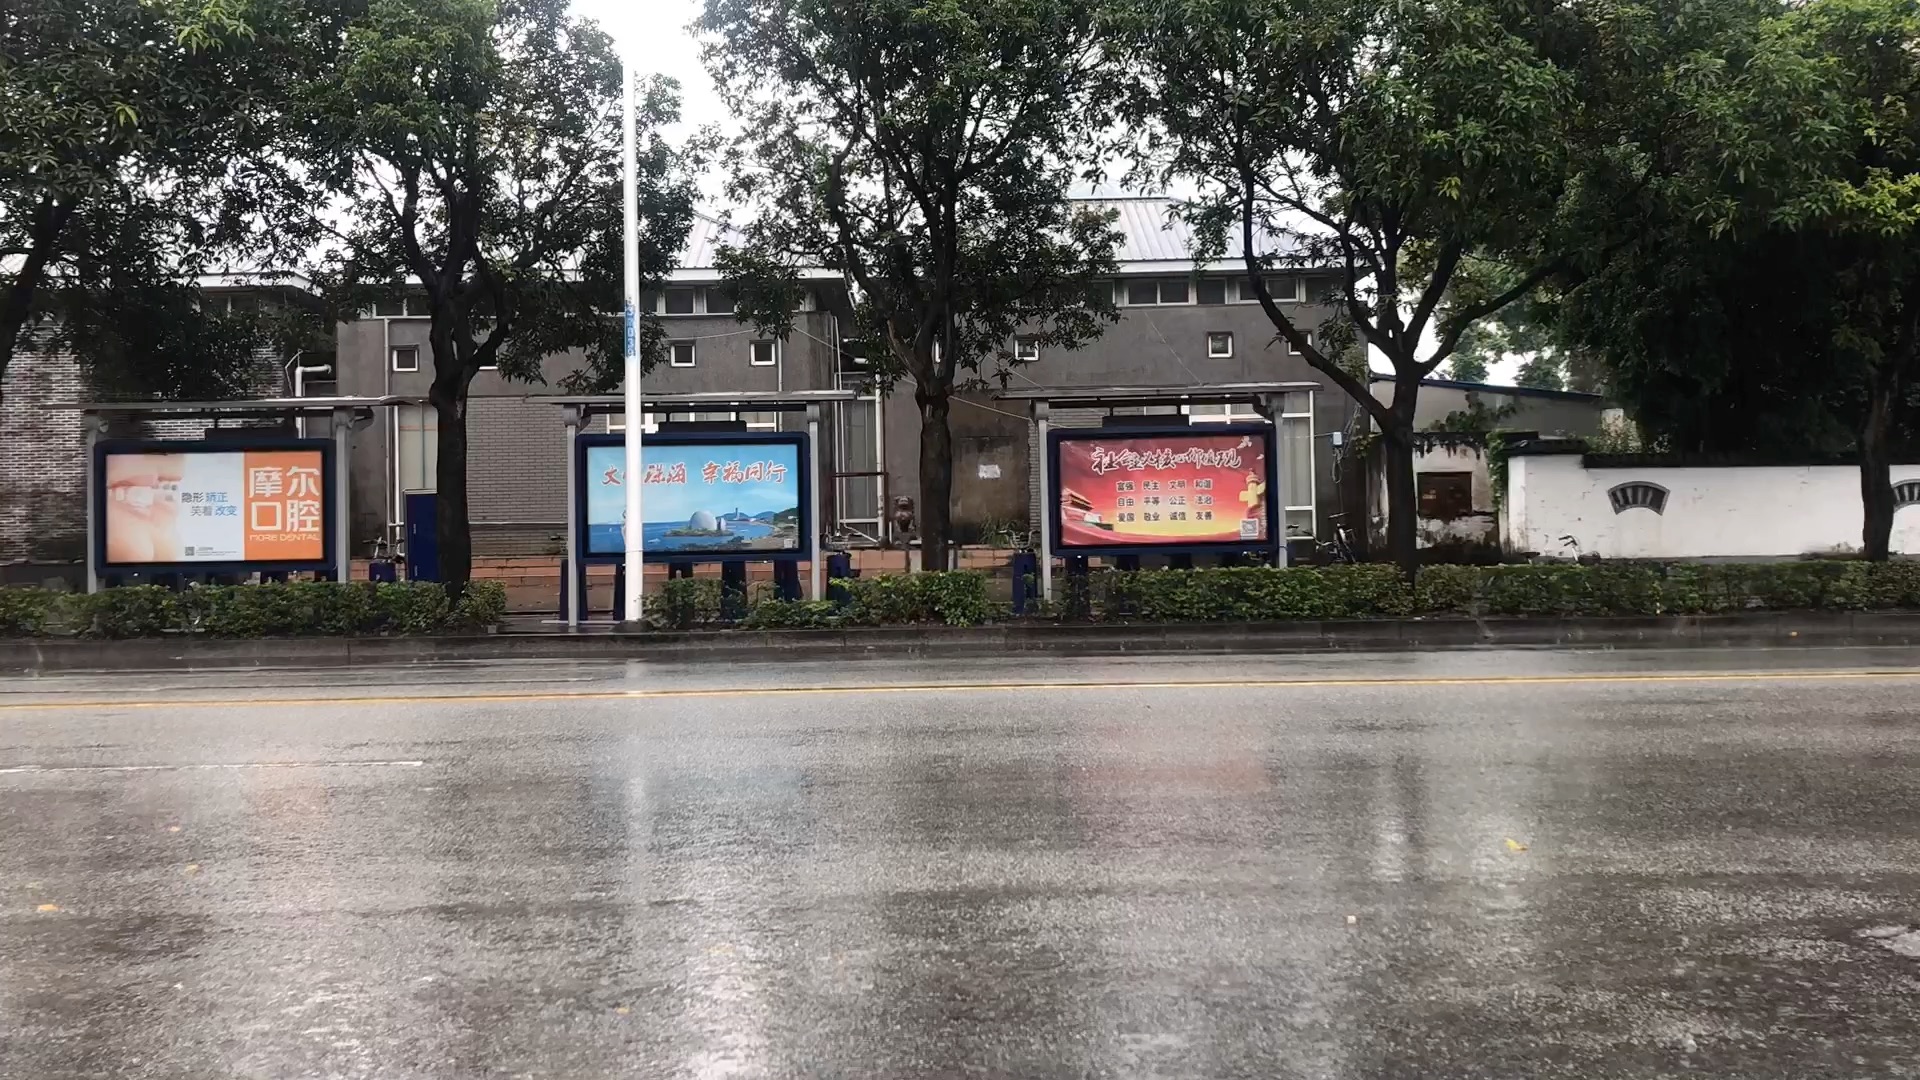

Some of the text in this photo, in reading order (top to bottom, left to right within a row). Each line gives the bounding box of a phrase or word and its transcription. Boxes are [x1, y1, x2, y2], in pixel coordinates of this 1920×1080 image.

[602, 460, 787, 485] 文珠海 幸福同行
[249, 466, 320, 498] 摩尔
[1116, 479, 1212, 492] 富强 民主 文明 和谐
[1117, 495, 1213, 507] 自由 平等 公正 法治
[250, 499, 320, 533] 口腔
[1117, 511, 1212, 522] 爱国 敬业 诚信 友善
[250, 533, 320, 542] MORE DENTAL
